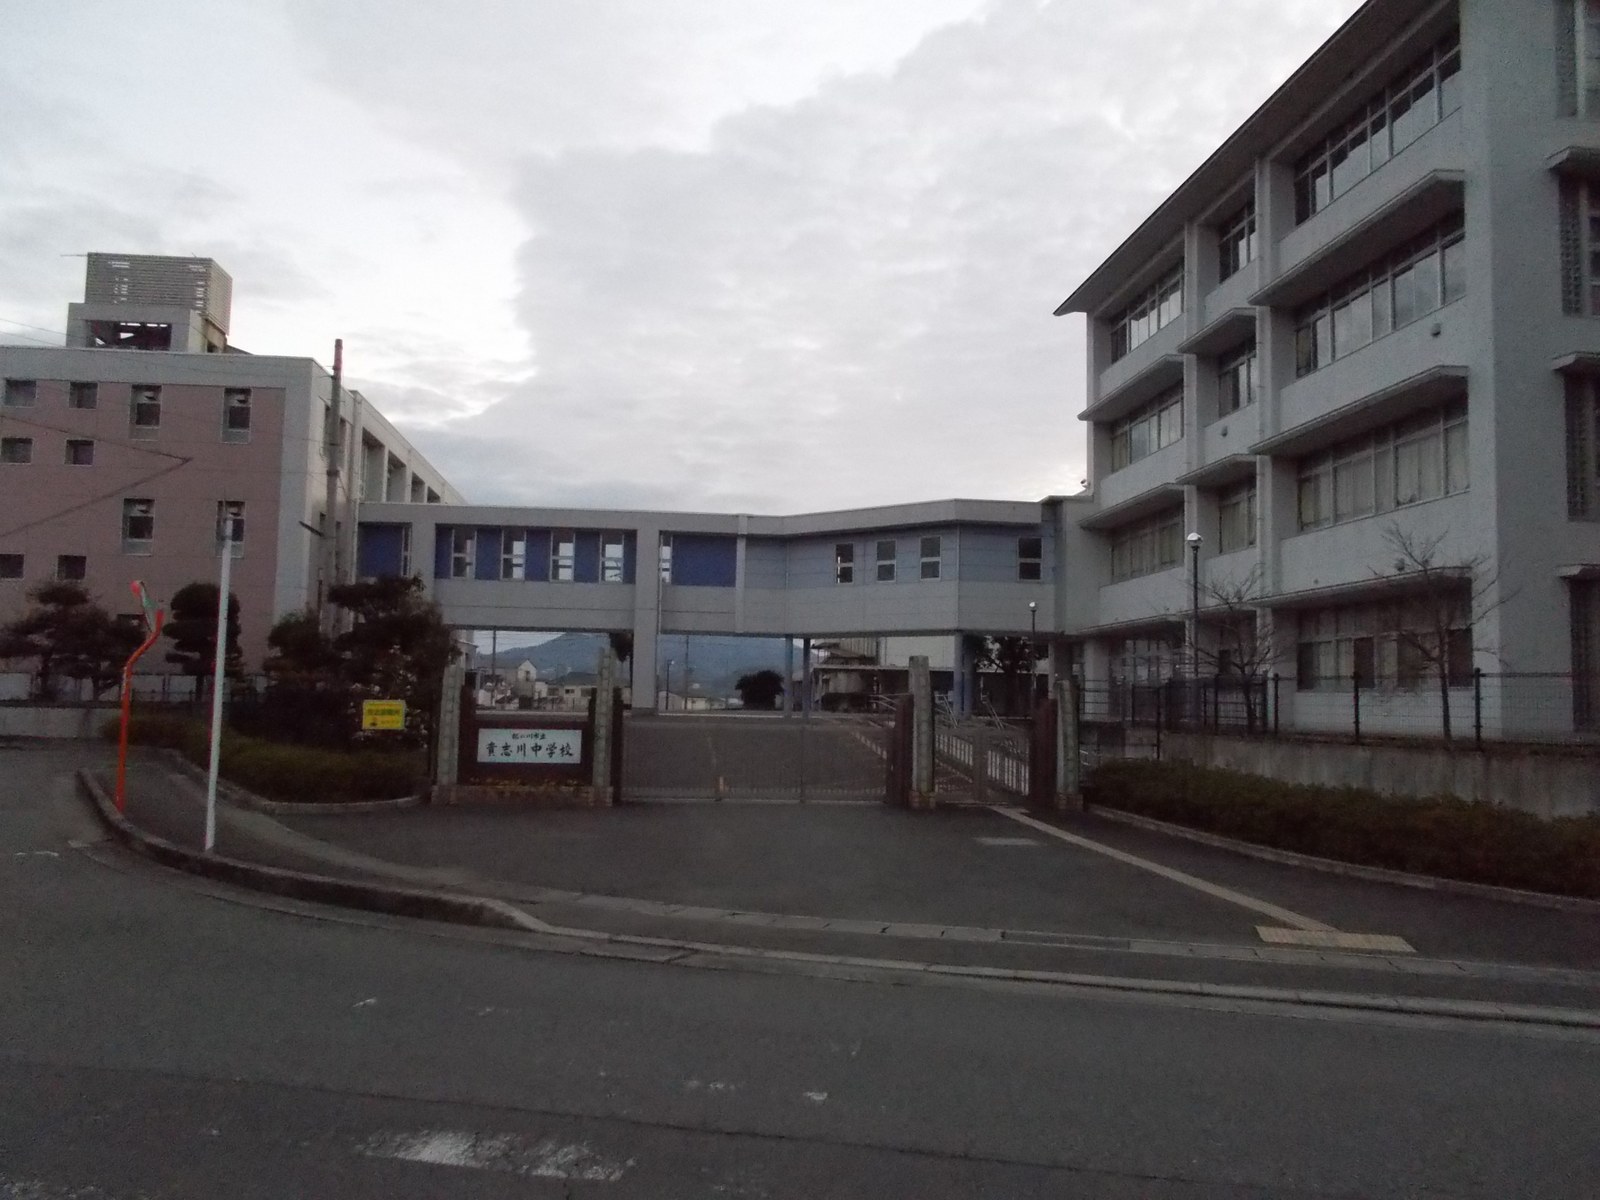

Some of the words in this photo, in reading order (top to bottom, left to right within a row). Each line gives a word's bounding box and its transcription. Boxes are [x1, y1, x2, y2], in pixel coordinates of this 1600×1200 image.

[486, 741, 574, 759] 貴志川中学校
